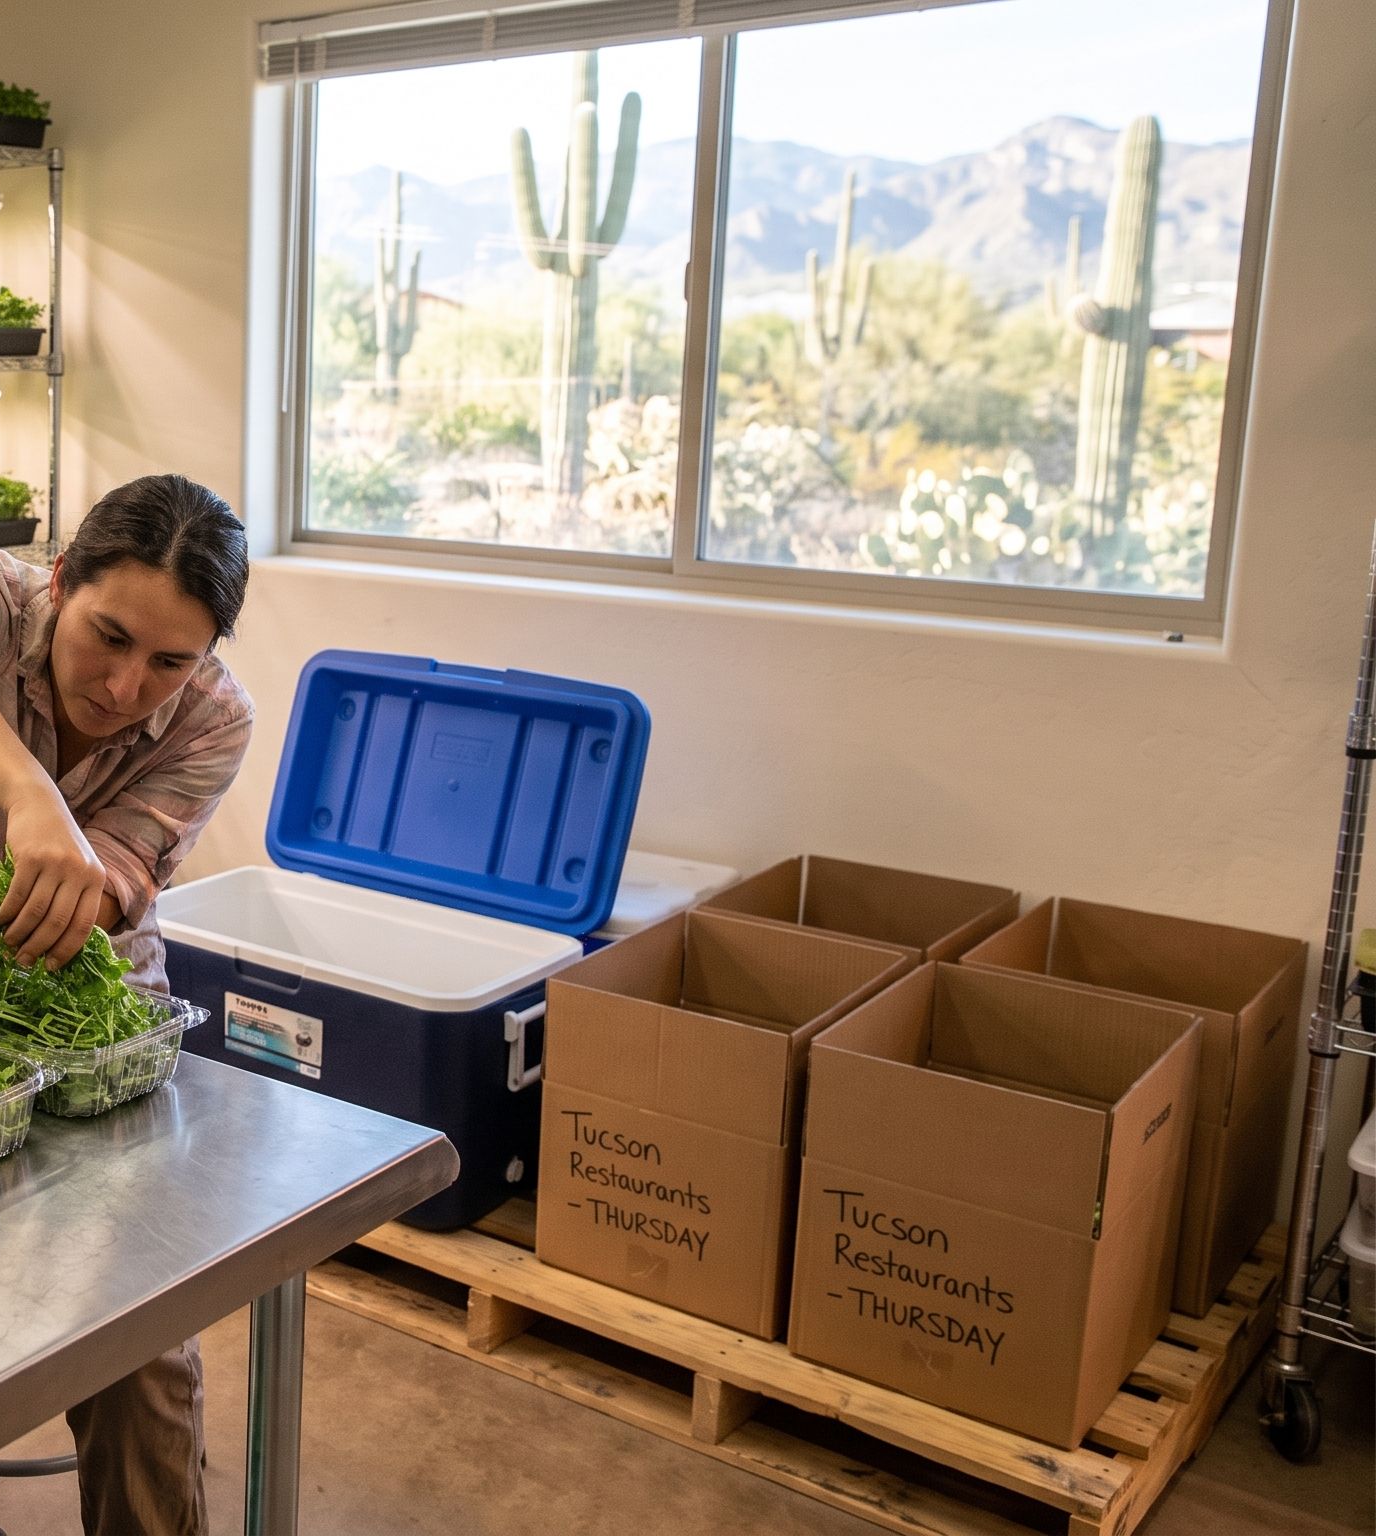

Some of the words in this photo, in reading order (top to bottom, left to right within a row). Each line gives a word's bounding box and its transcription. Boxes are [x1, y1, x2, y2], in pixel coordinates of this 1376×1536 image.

[561, 1110, 661, 1166] Tucson
[570, 1151, 712, 1215] Restaurants
[823, 1189, 949, 1253] Tucson
[835, 1233, 1014, 1314] Restaurants
